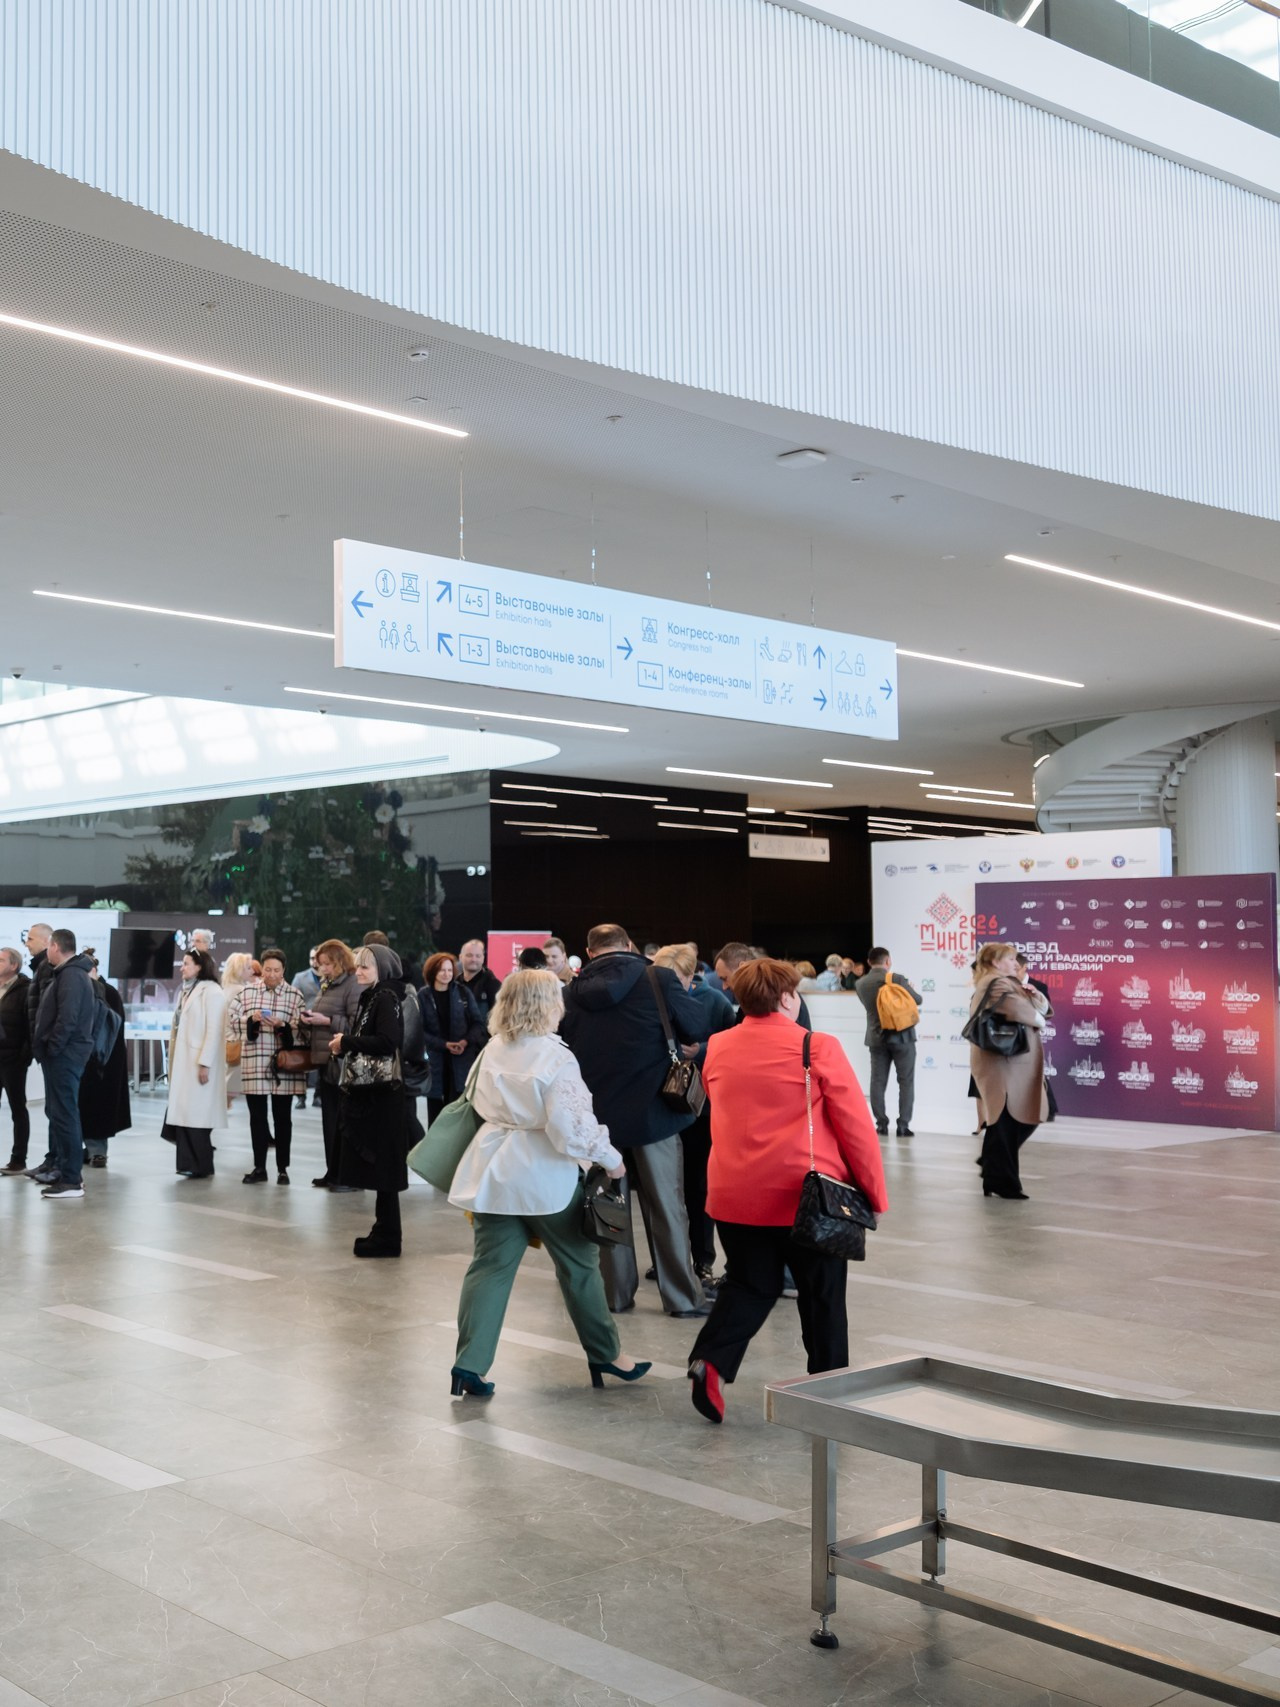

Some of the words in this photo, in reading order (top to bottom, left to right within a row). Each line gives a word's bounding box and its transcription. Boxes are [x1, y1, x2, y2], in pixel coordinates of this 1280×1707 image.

[465, 594, 483, 608] 4-5
[495, 592, 574, 617] Выставочные
[576, 608, 604, 623] залы
[495, 610, 533, 625] Exhibition
[534, 618, 553, 628] halls
[667, 622, 740, 645] Конгресс-холл
[466, 643, 483, 657] 1-3
[668, 639, 700, 653] Congress
[700, 643, 712, 653] hall
[496, 640, 574, 664] Выставочные
[577, 655, 605, 669] залы
[496, 658, 533, 672] Exhibition
[534, 663, 553, 675] halls
[643, 668, 658, 681] 1-4
[668, 666, 752, 690] Конференц-залы
[668, 683, 708, 697] Conference
[708, 688, 728, 700] rooms
[1045, 953, 1053, 962] И
[1055, 954, 1134, 963] РАДИОЛОГОВ
[1039, 962, 1048, 970] И
[1050, 962, 1103, 971] ЕВРАЗИИ
[1180, 991, 1205, 1001] 2021
[1227, 993, 1260, 1002] 2020
[1118, 1071, 1150, 1081] 2004
